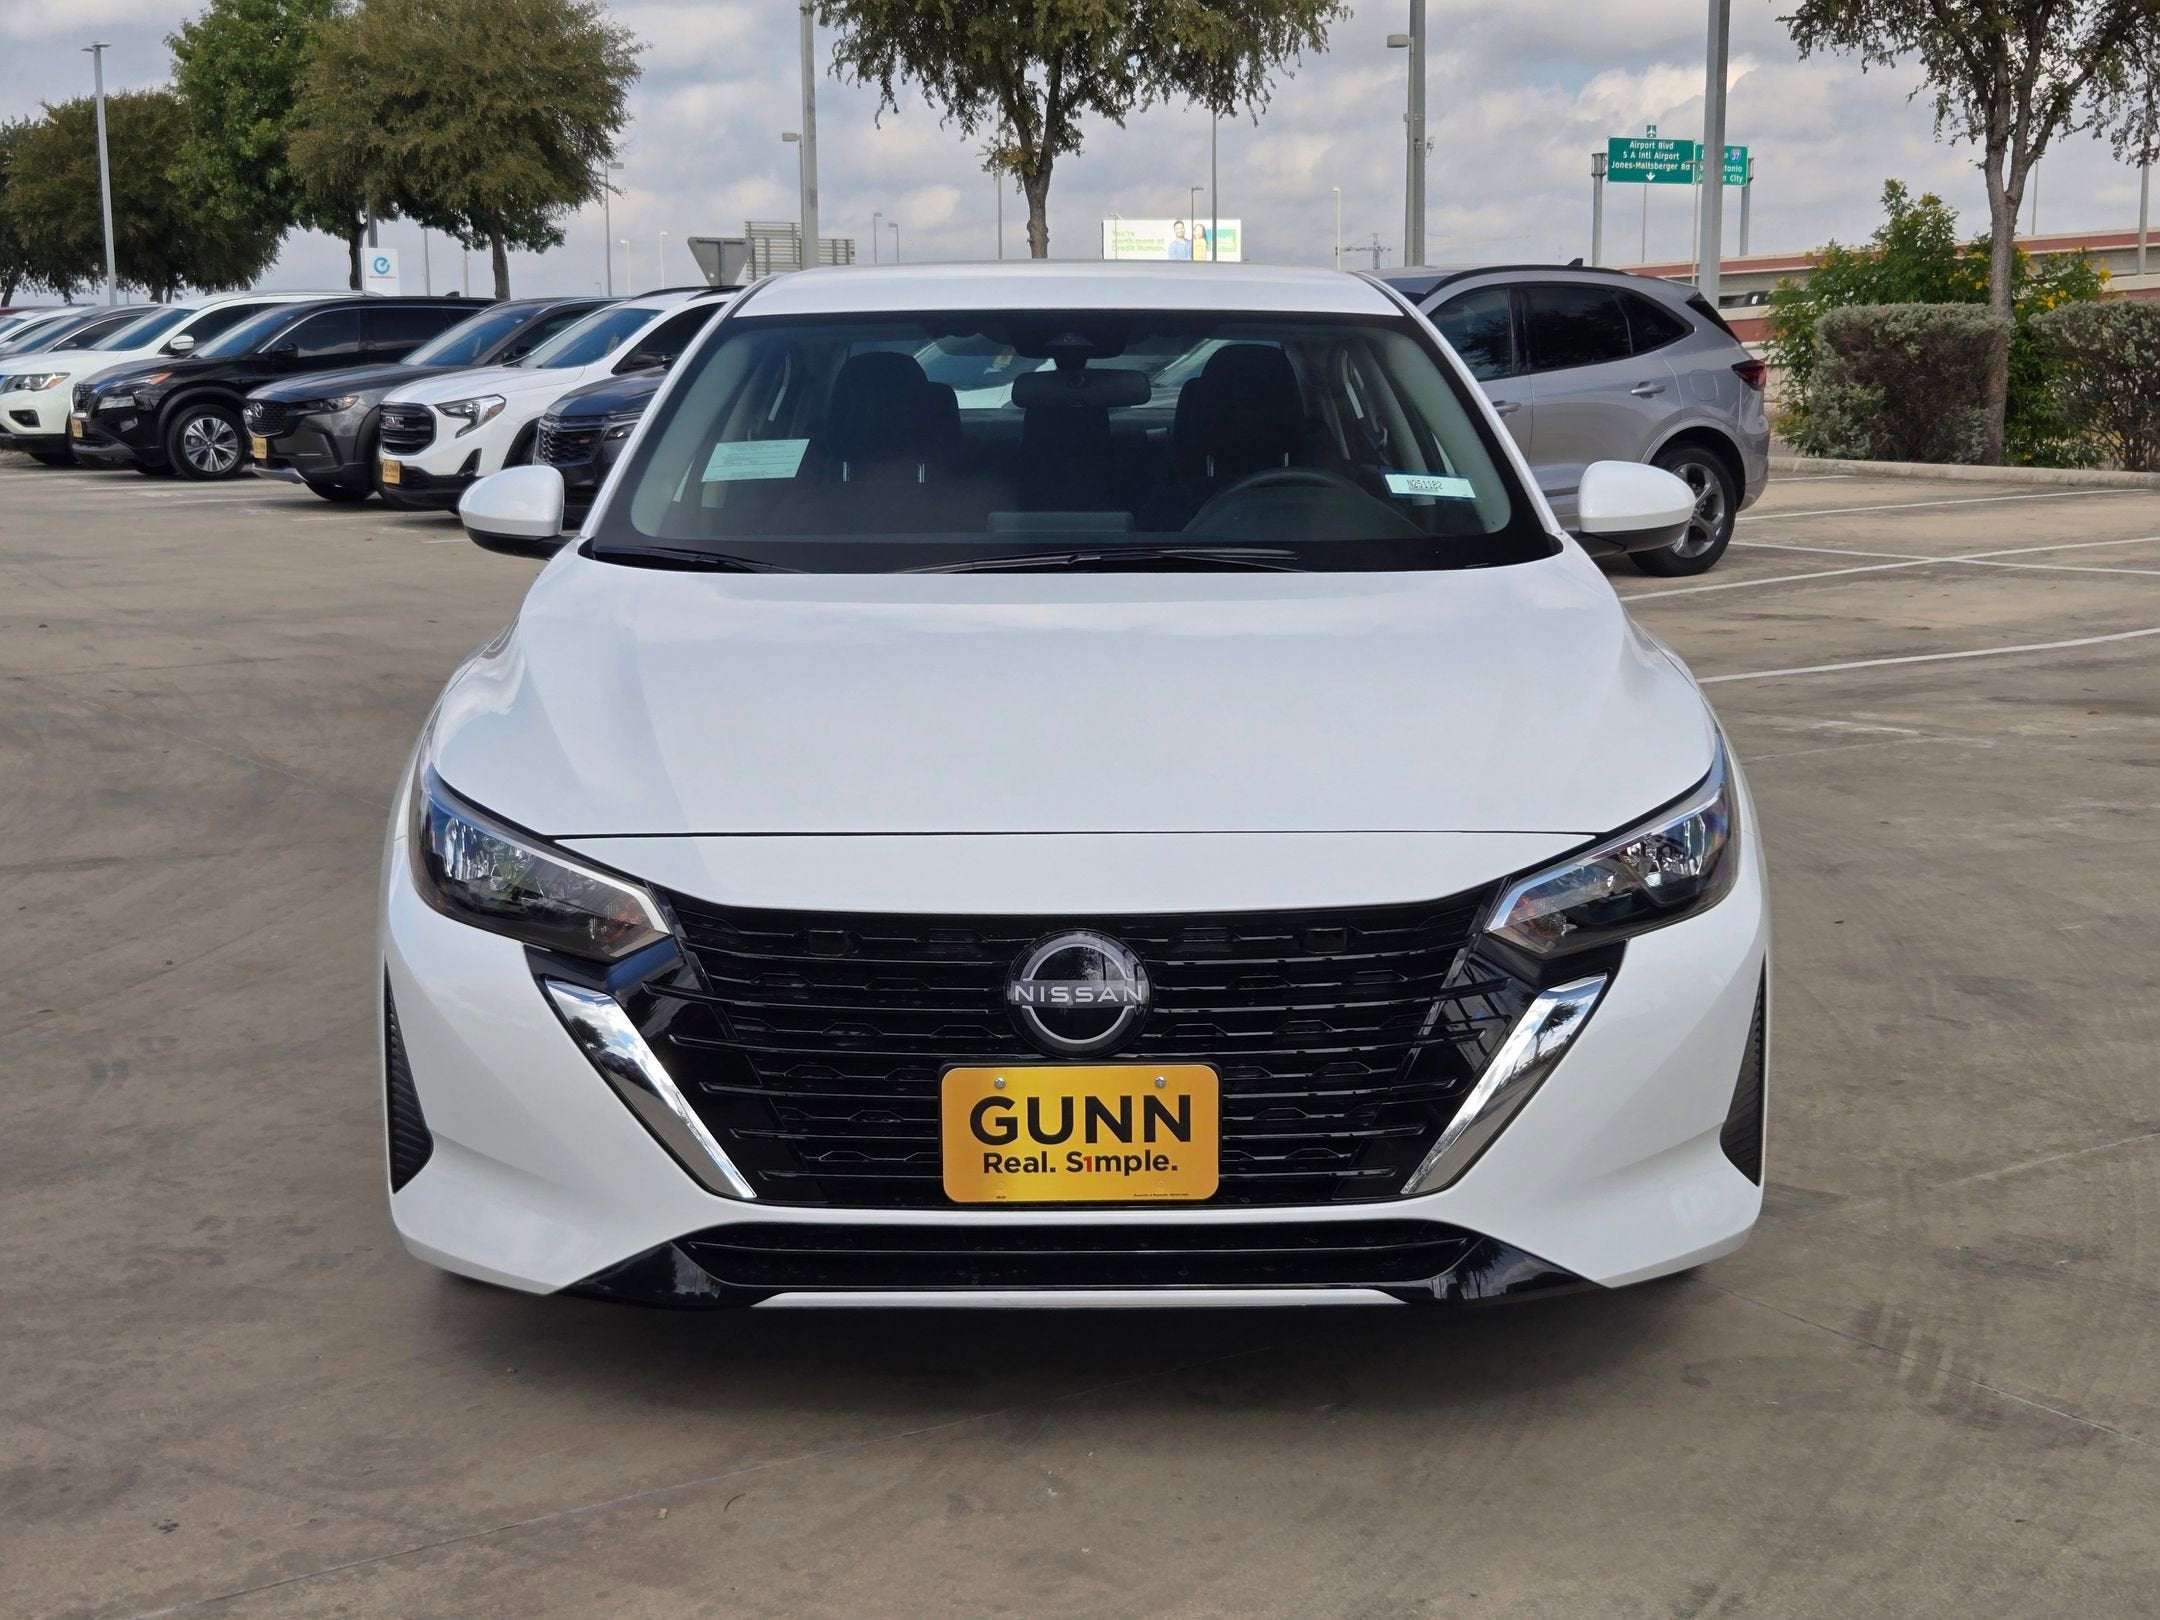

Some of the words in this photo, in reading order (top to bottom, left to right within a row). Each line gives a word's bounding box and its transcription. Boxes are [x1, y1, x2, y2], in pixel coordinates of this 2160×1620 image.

[1629, 141, 1655, 150] Airport
[1658, 141, 1674, 150] Blvd
[1622, 151, 1628, 159] S
[1630, 151, 1636, 159] A
[1653, 152, 1680, 161] Airport
[1611, 161, 1678, 172] Jones-Maltsberger
[1729, 175, 1744, 184] City
[1014, 985, 1143, 1003] NISSAN
[969, 1094, 1192, 1146] GUNN
[983, 1150, 1057, 1175] Real.
